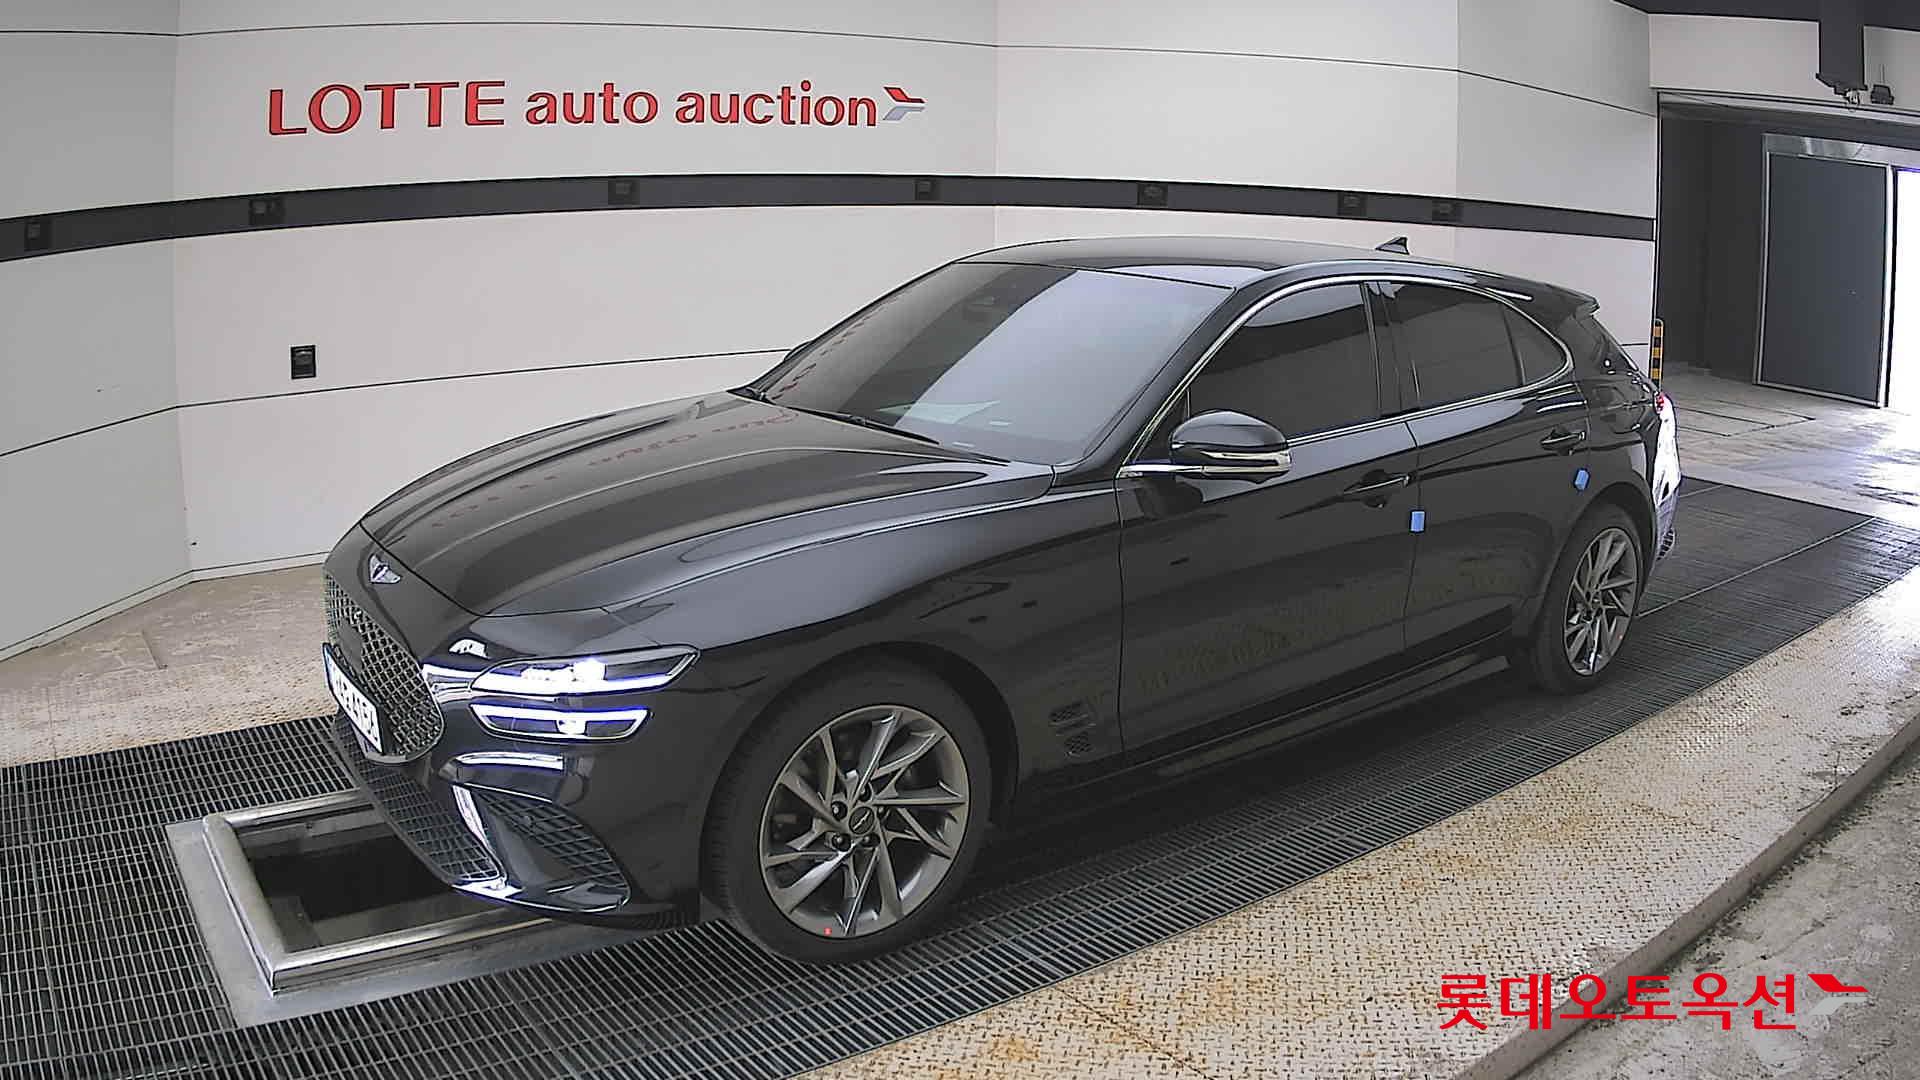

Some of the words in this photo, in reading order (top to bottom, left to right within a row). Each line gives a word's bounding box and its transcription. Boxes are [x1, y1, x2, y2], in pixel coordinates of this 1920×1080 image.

[267, 80, 506, 136] LOTTE
[525, 82, 659, 126] auto
[676, 80, 878, 127] auction
